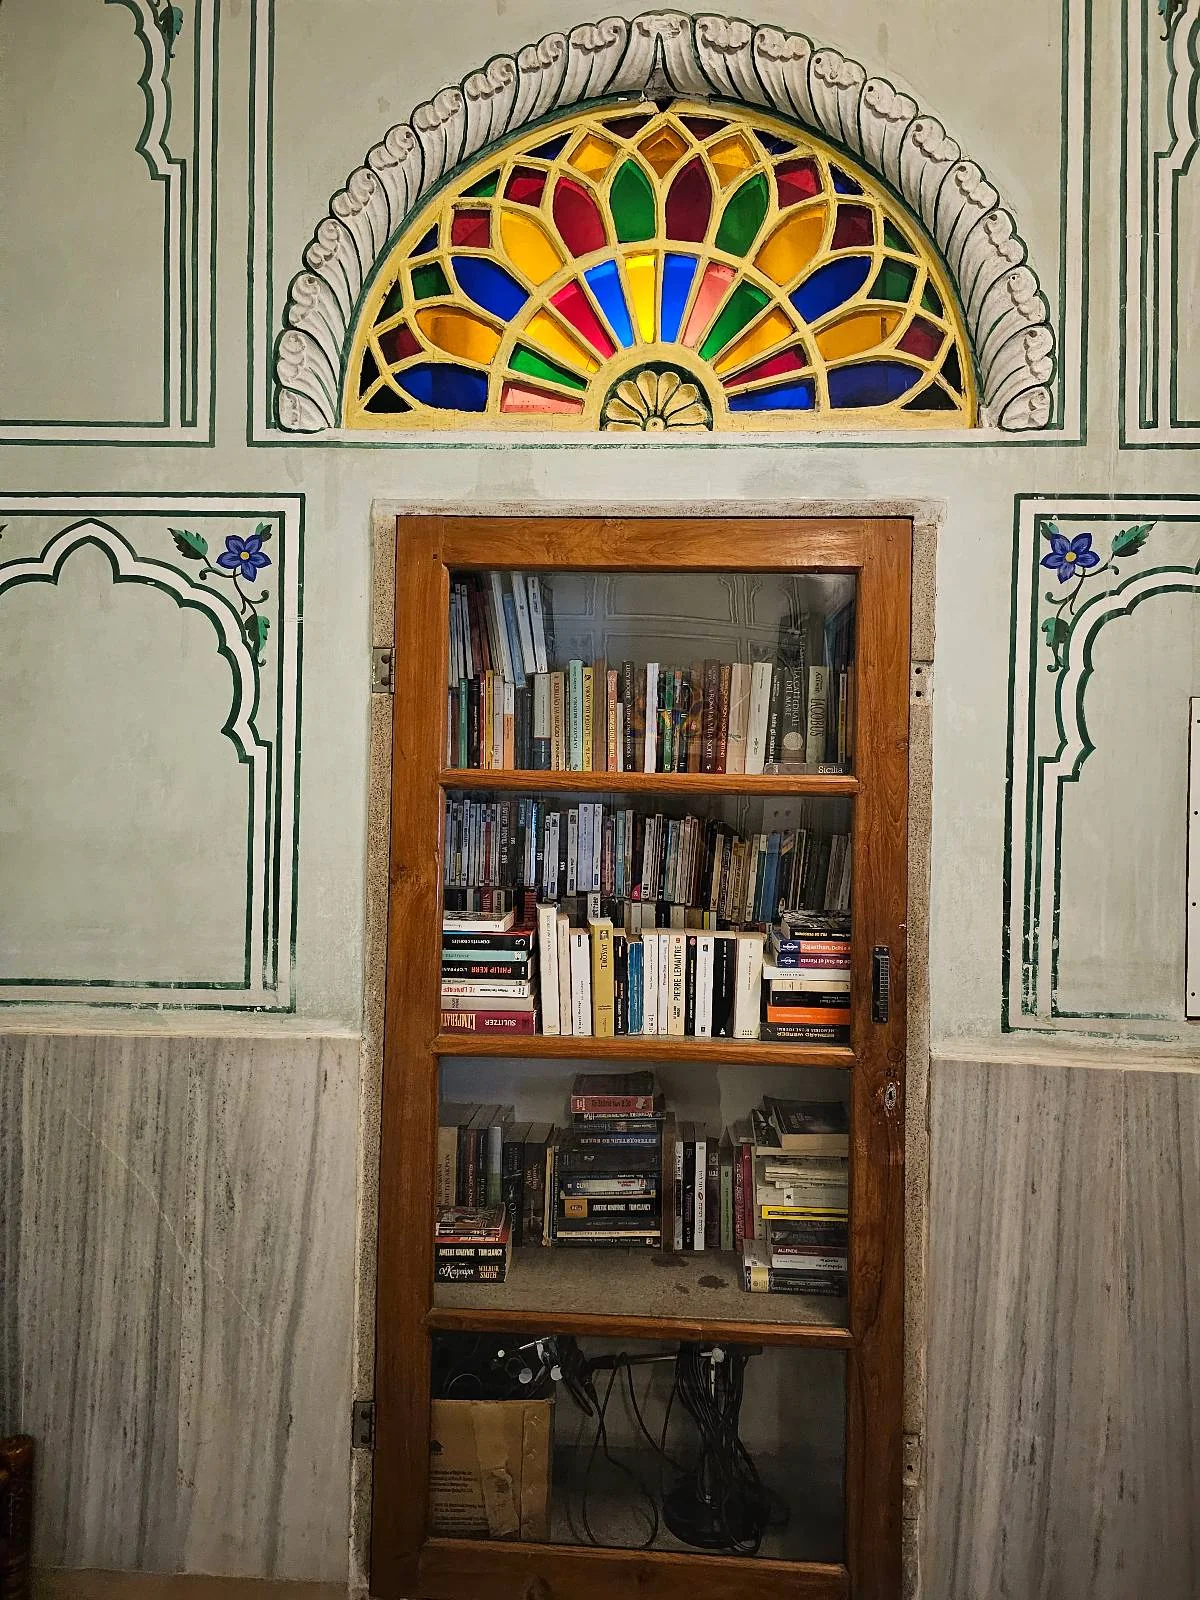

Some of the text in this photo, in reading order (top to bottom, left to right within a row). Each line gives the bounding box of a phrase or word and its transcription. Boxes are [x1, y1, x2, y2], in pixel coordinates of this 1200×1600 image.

[785, 680, 793, 717] DEL MARE
[810, 698, 825, 737] IACOBUS
[818, 765, 843, 774] Sicilia
[600, 943, 608, 970] TROYAT
